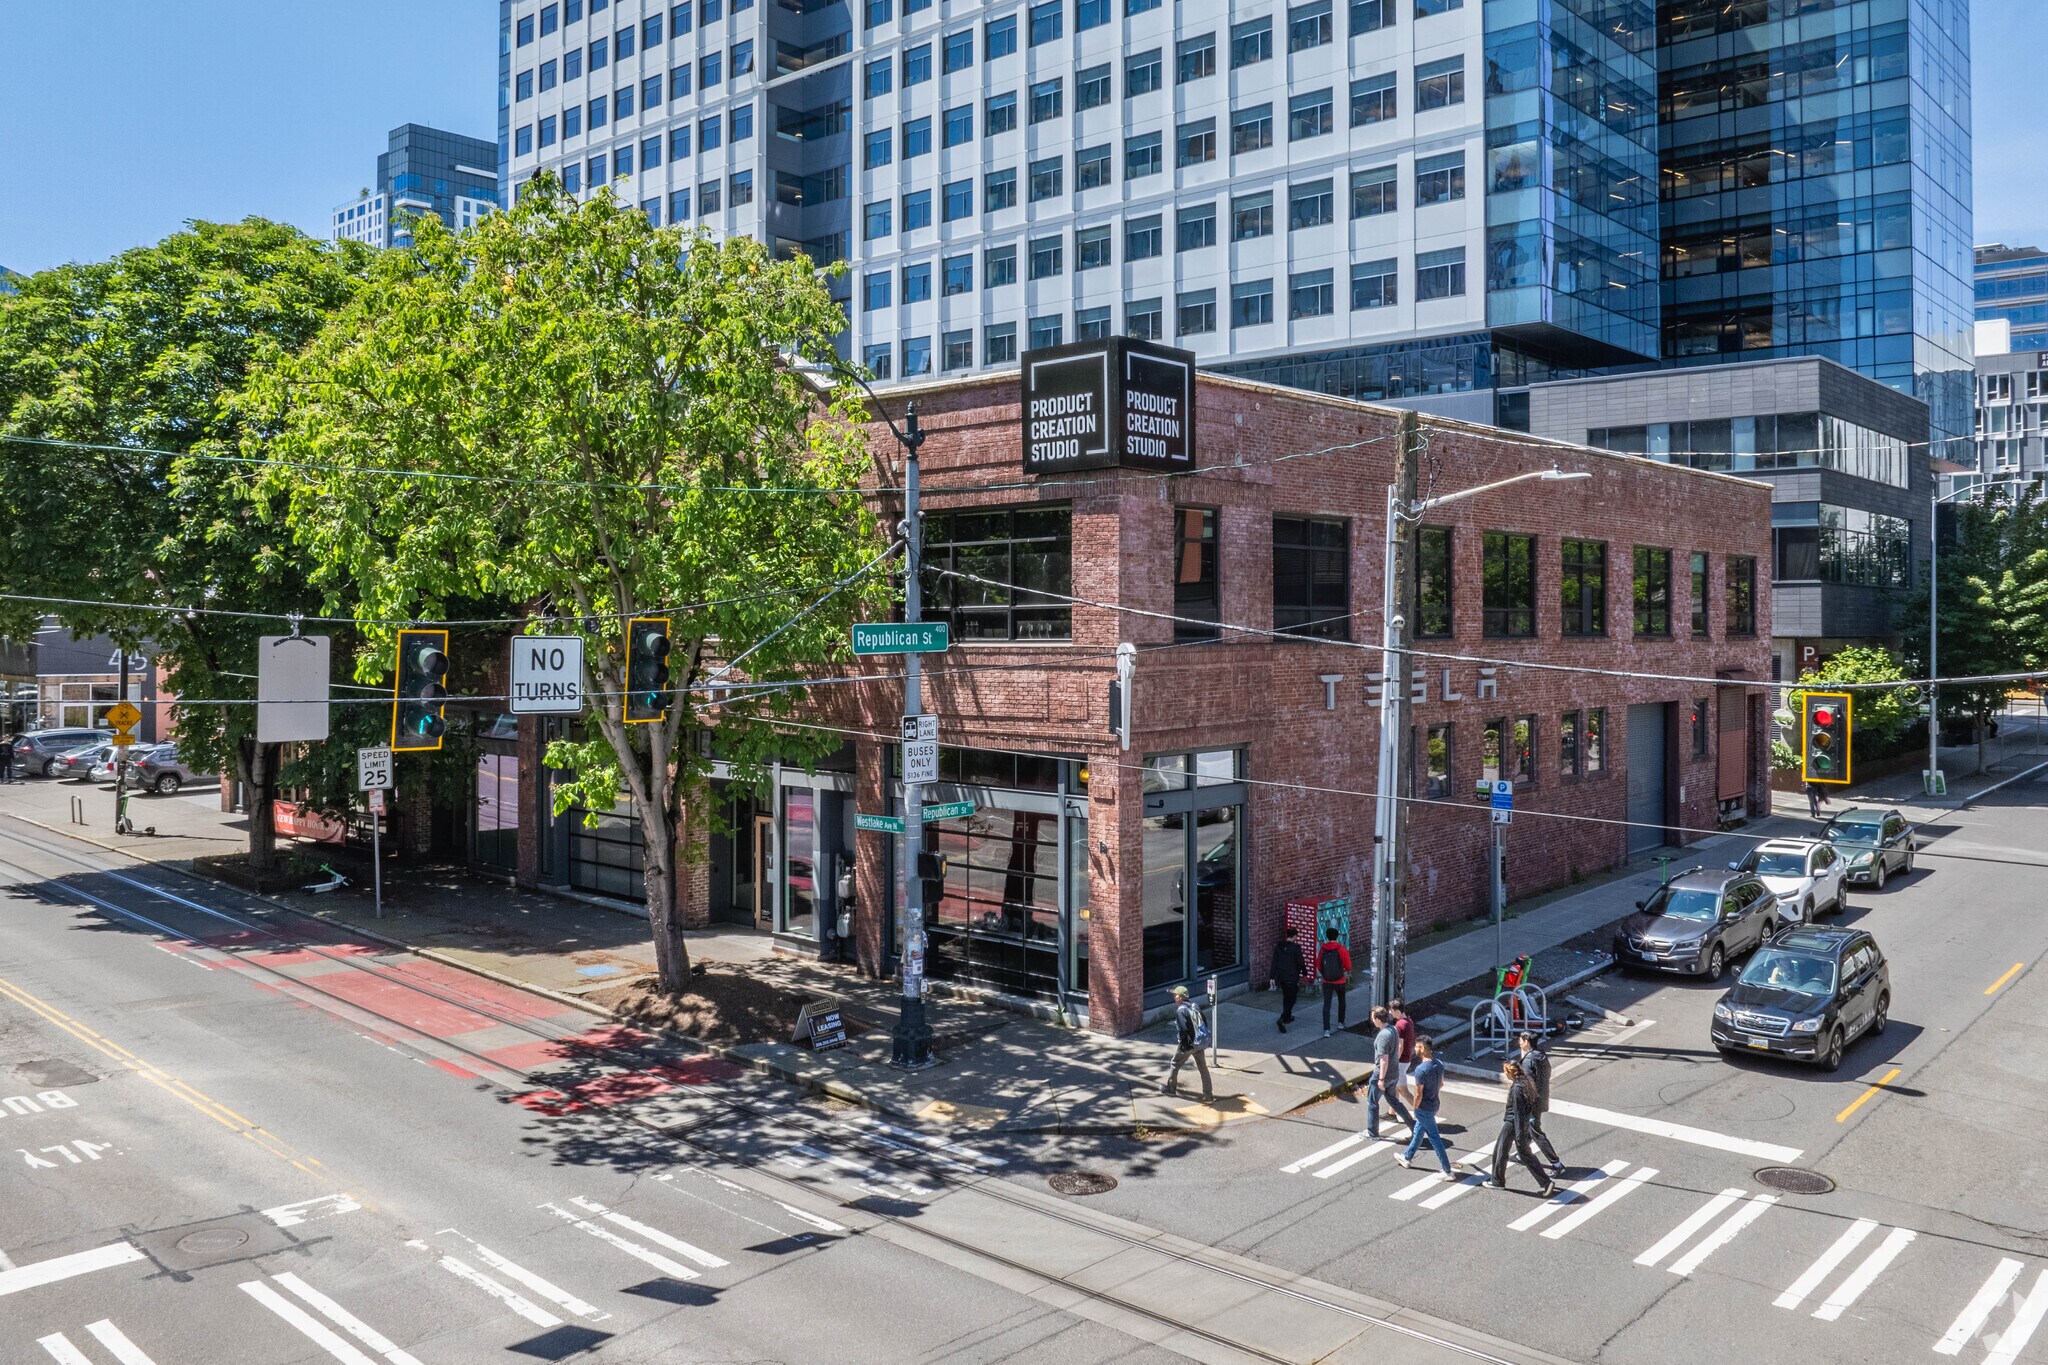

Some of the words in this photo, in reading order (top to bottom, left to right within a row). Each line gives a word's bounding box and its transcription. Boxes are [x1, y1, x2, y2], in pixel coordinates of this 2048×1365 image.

[1031, 392, 1093, 418] PRODUCT
[1126, 390, 1177, 416] PRODUCT
[1031, 414, 1096, 440] CREATION
[1126, 413, 1179, 438] CREATION
[1031, 439, 1079, 462] STUDIO
[1127, 435, 1166, 458] STUDIO
[935, 625, 946, 633] 400
[857, 631, 918, 650] Republican
[922, 632, 932, 645] St
[531, 648, 564, 671] NO
[1803, 646, 1815, 661] P
[515, 682, 577, 701] TURNS
[918, 720, 935, 728] RIGHT
[919, 729, 935, 737] LANE
[361, 751, 389, 760] SPEED
[907, 746, 934, 757] BUSES
[364, 760, 386, 769] LIMIT
[910, 758, 931, 768] ONLY
[364, 770, 387, 786] 25
[922, 806, 959, 819] Republican
[961, 807, 967, 815] St
[856, 816, 884, 829] Westlake
[884, 821, 893, 830] Ave
[825, 1013, 840, 1022] NOW
[817, 1020, 842, 1031] LEASING
[0, 1090, 79, 1118] BU
[16, 1140, 128, 1169] NLY
